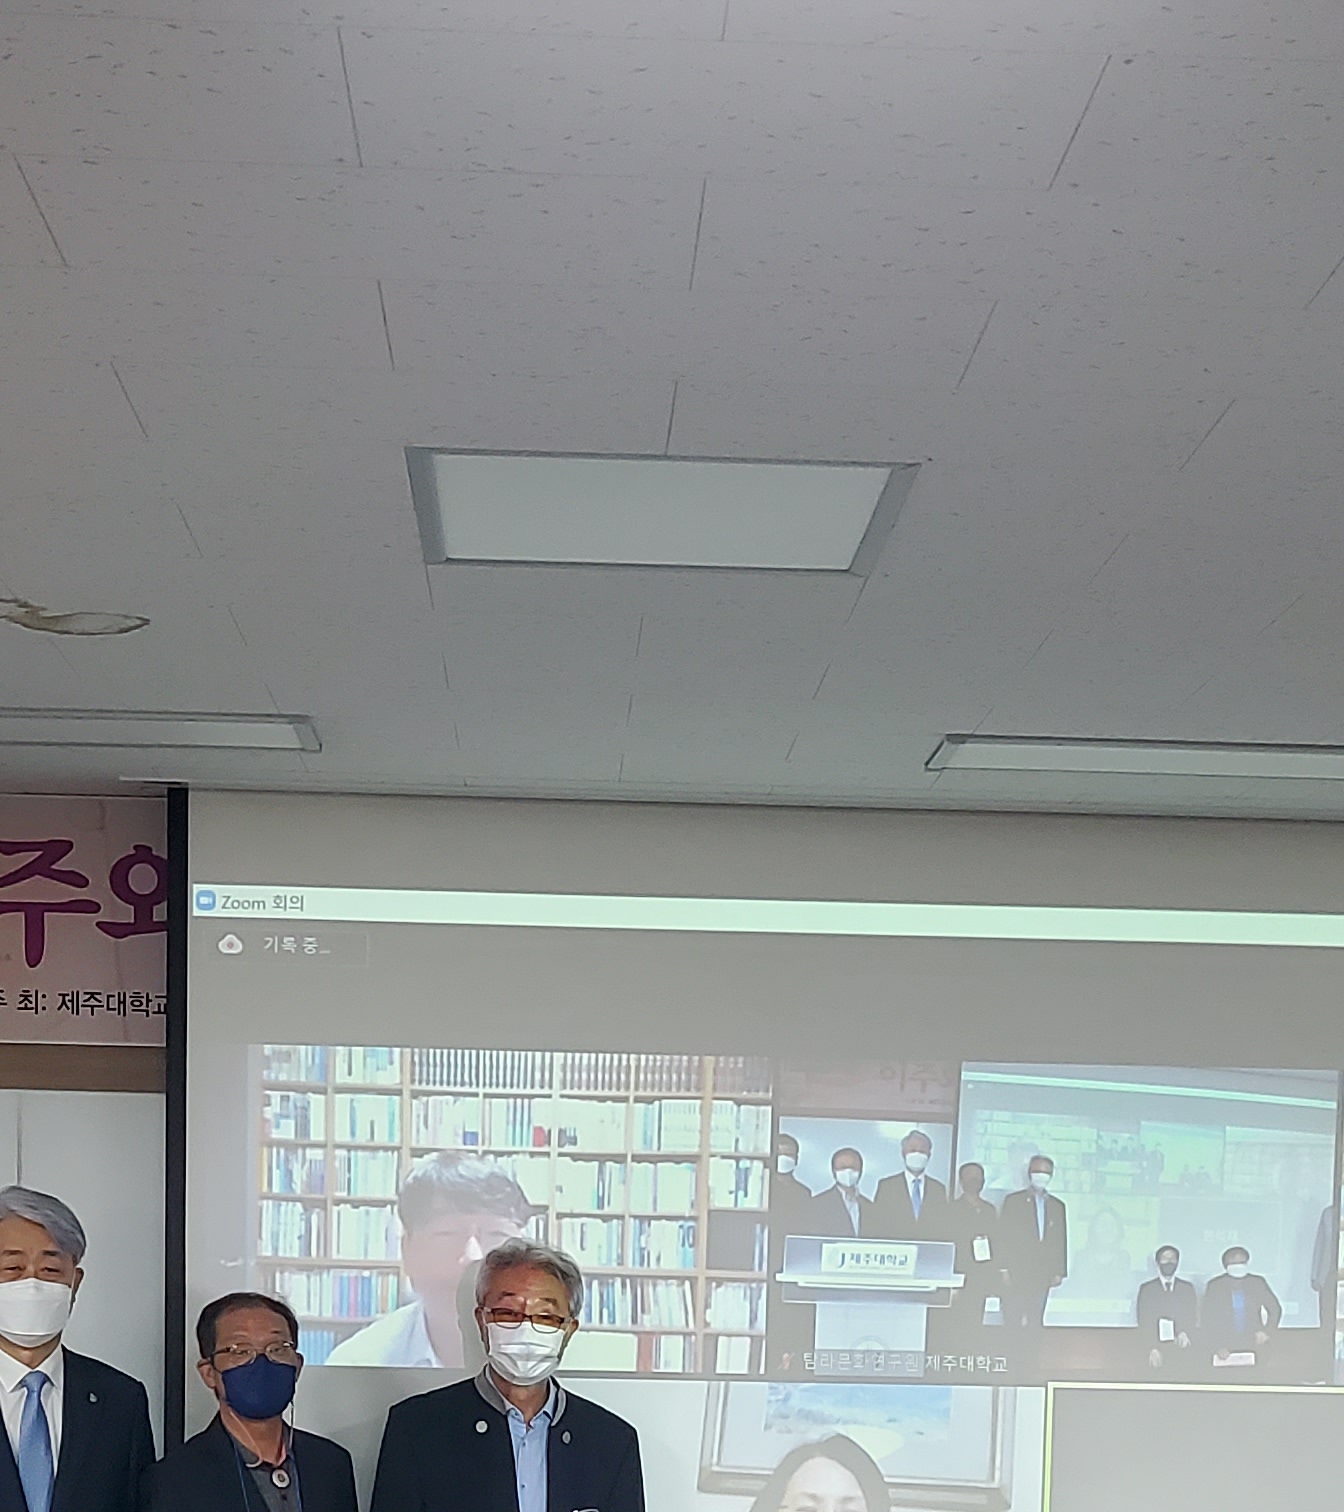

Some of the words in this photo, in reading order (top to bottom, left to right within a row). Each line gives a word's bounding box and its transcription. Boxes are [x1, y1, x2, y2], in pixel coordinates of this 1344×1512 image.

[221, 895, 266, 910] Zoom
[272, 894, 305, 912] 회의
[264, 935, 297, 953] 기록
[925, 1354, 1008, 1373] 제주대학교
